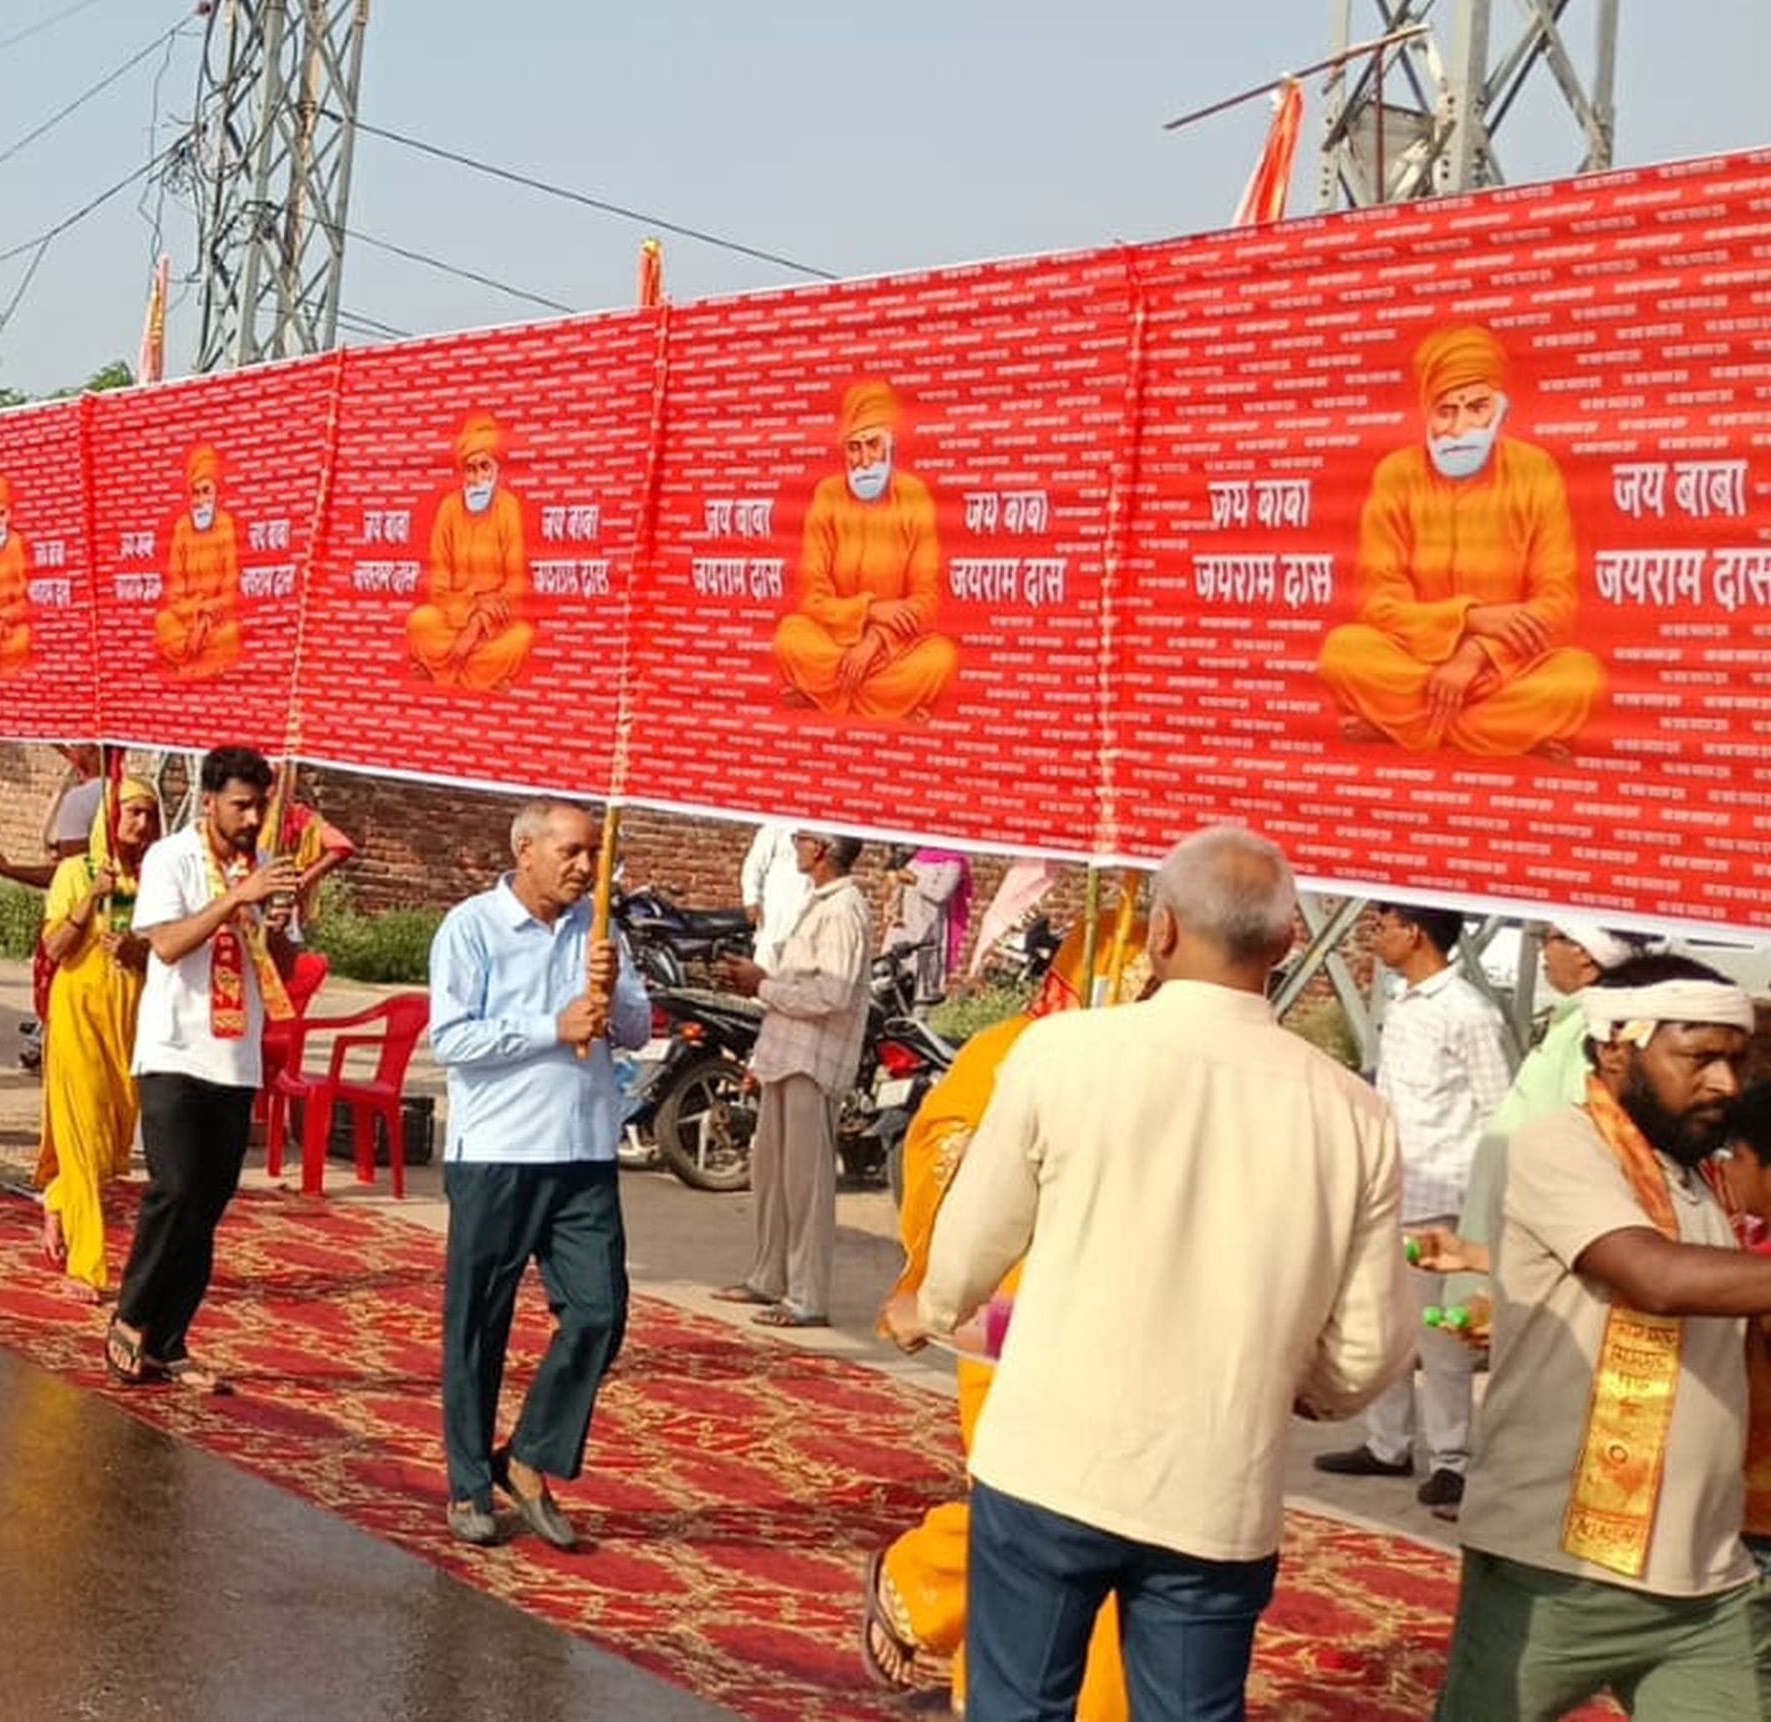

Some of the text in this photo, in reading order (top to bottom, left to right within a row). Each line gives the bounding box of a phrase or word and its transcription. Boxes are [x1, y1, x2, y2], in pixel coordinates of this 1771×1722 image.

[963, 491, 998, 534] जय
[1208, 479, 1311, 528] जय बाबा
[1612, 459, 1749, 519] जय बाबा
[949, 557, 1067, 609] जयराम दास
[1192, 553, 1333, 610] जयराम दास
[1595, 548, 1771, 613] जयराम दास
